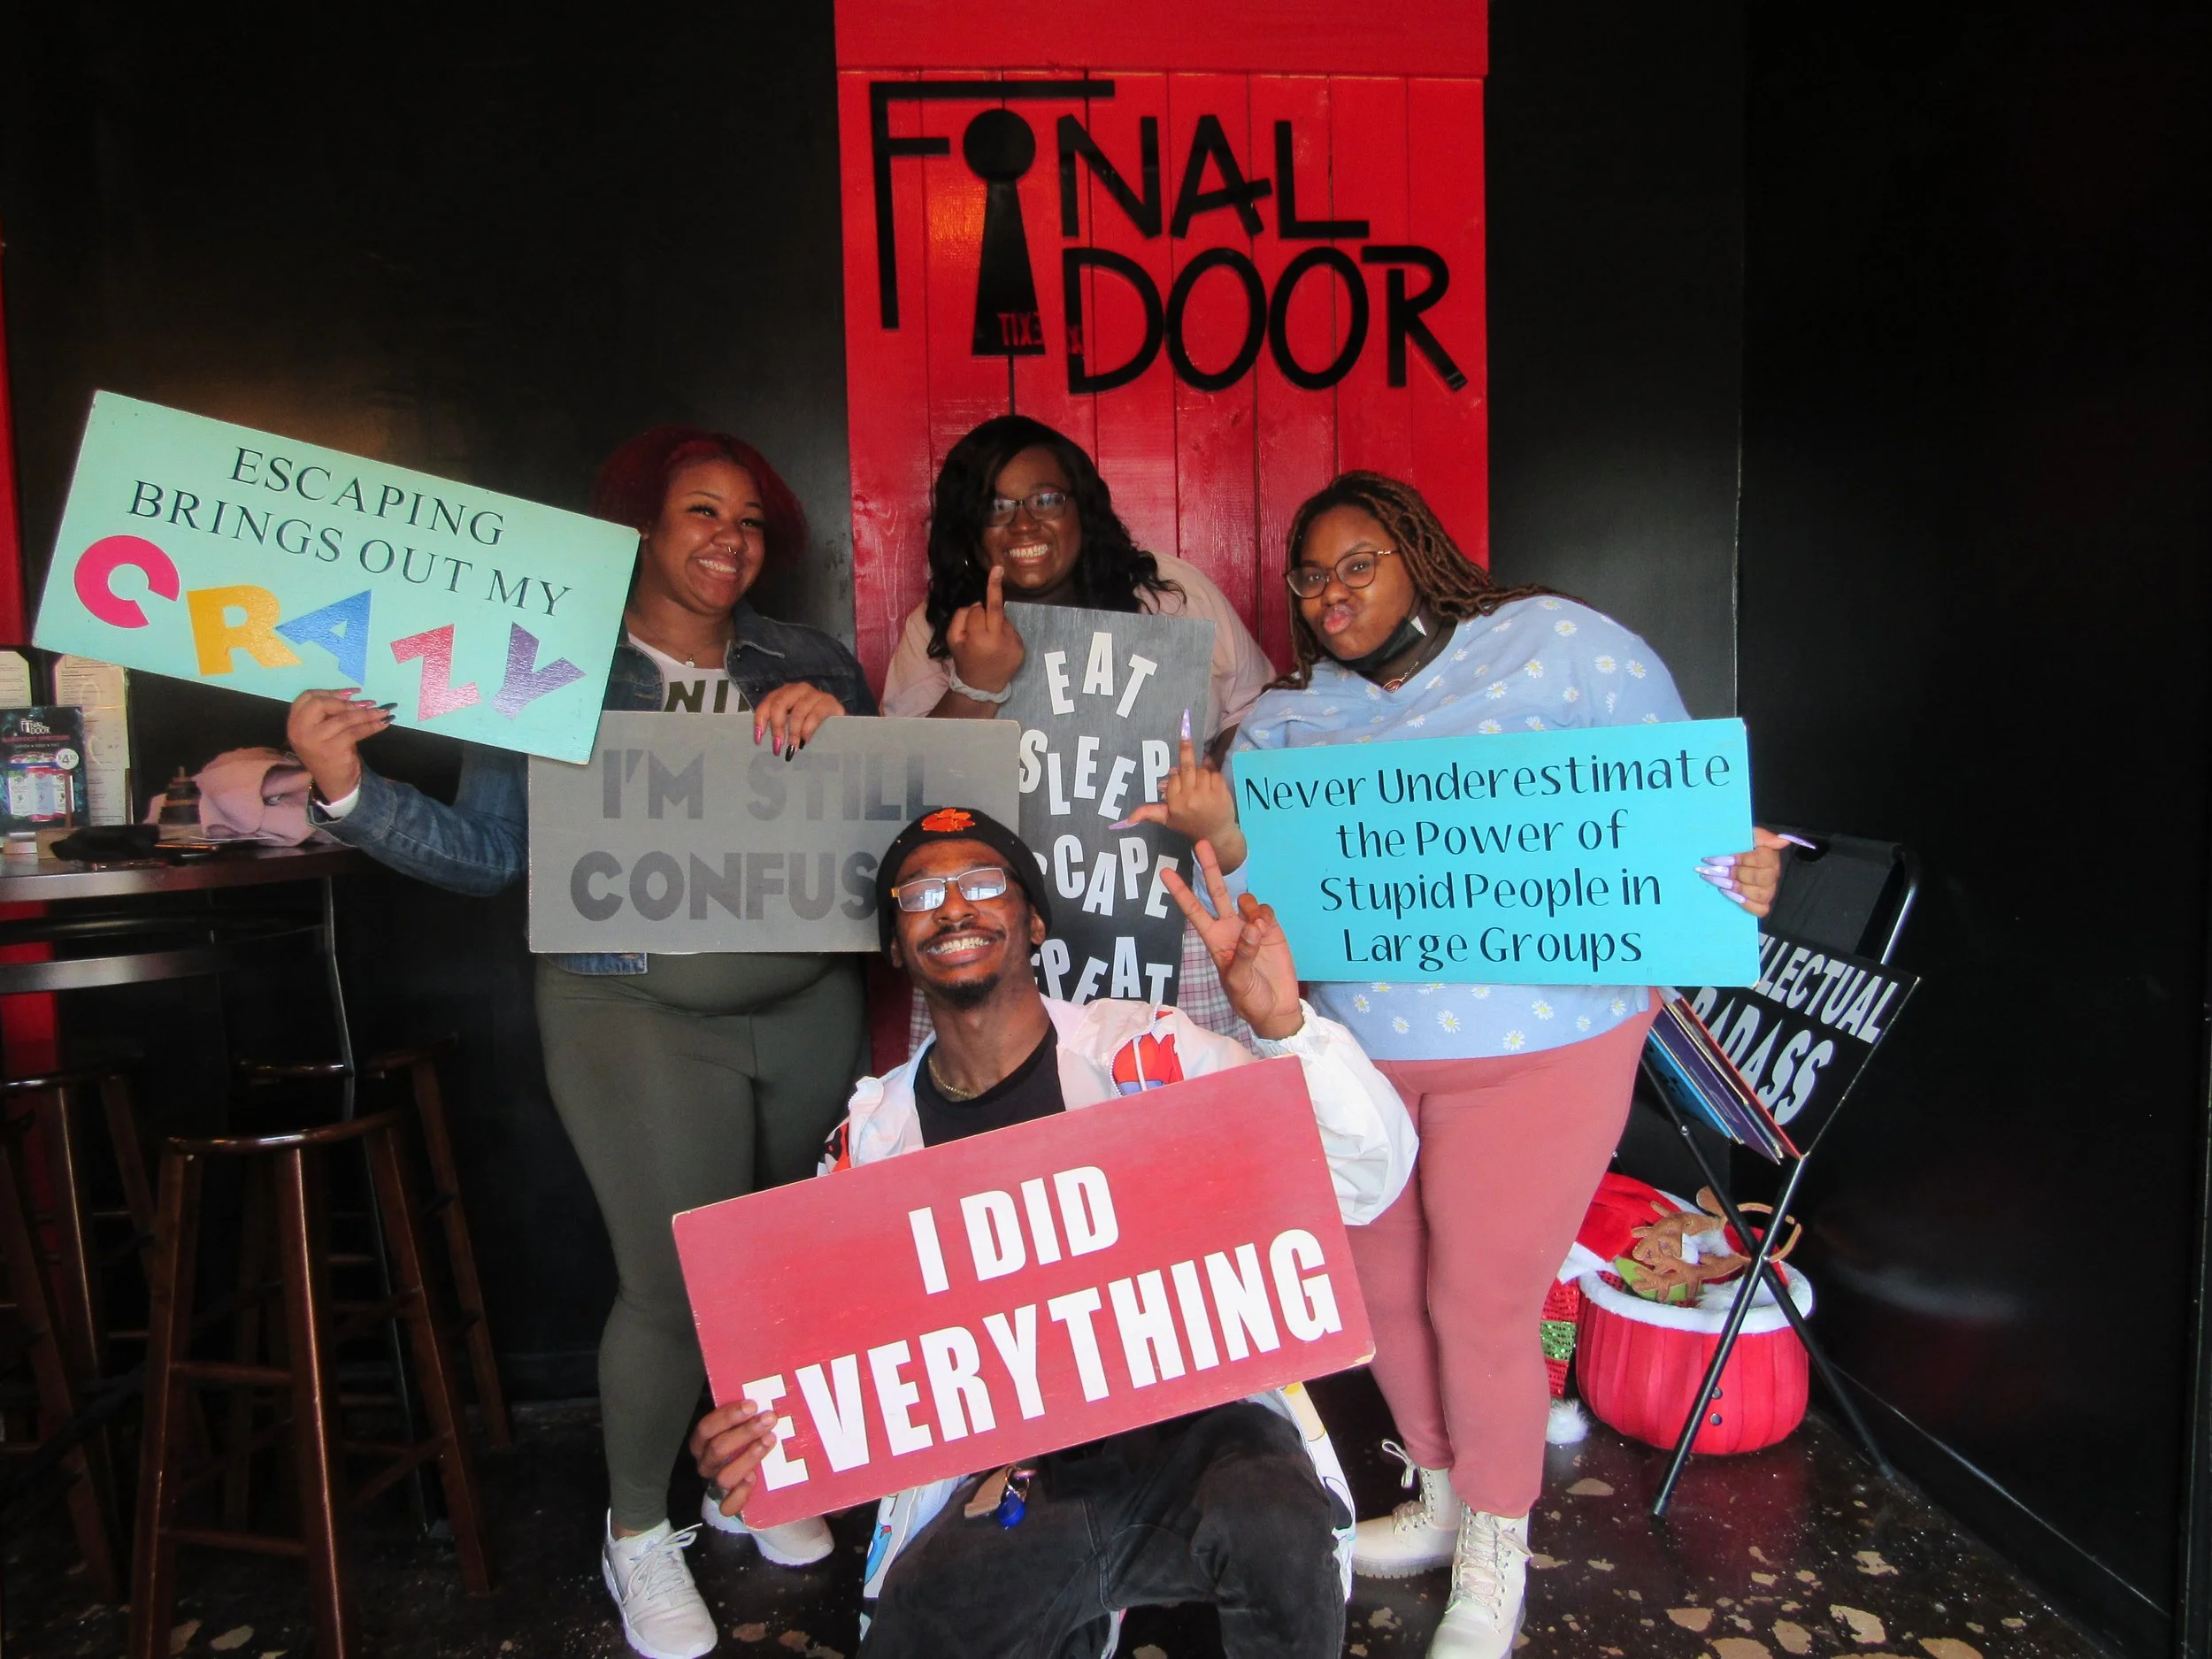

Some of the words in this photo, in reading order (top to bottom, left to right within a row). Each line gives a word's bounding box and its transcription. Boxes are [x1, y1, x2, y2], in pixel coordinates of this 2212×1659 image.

[1063, 245, 1468, 396] DOOR
[231, 447, 505, 546] ESCAPING
[127, 480, 343, 563] BRINGS
[359, 539, 472, 593] OUT
[485, 568, 572, 618] MY
[74, 534, 587, 724] CRAZY
[1044, 632, 1158, 718] EAT
[603, 749, 704, 820] I'M
[747, 750, 943, 822] STILL
[1019, 729, 1171, 821] SLEEP
[1244, 775, 1367, 811] Never
[1378, 749, 1732, 804] Underestimate
[1335, 821, 1406, 859] the
[1415, 818, 1564, 856] Power
[1578, 808, 1630, 850] of
[569, 849, 879, 922] CONFUS
[1320, 871, 1455, 920] Stupid
[1464, 870, 1610, 918] People
[1621, 868, 1663, 905] in
[1342, 926, 1468, 972] Large
[1479, 926, 1643, 972] Groups
[908, 1206, 949, 1294] I
[959, 1165, 1120, 1282] DID
[741, 1229, 1343, 1492] EVERYTHING
